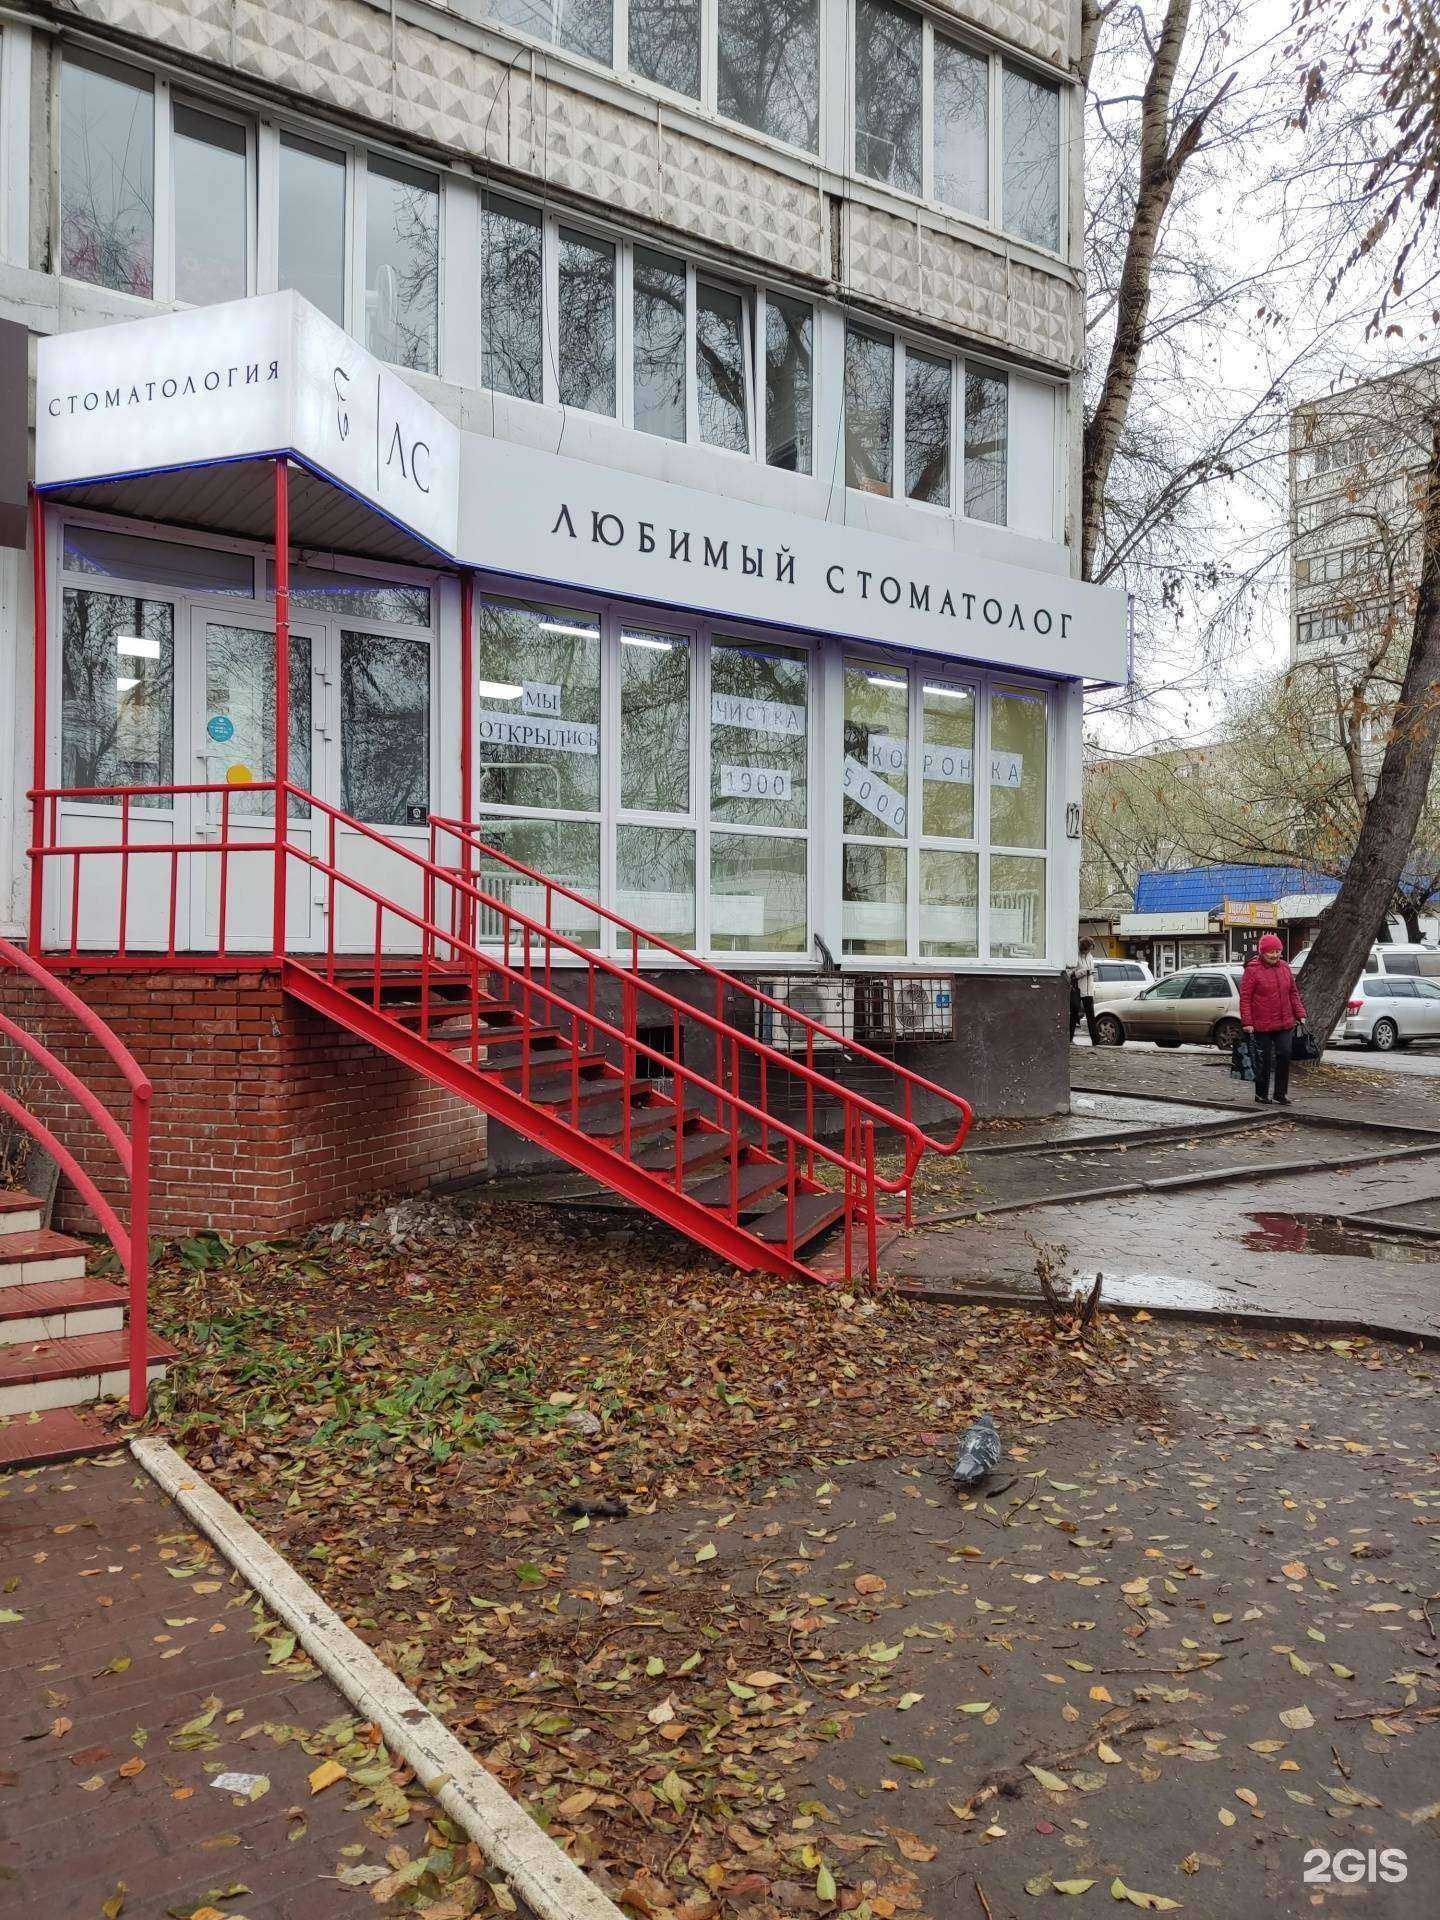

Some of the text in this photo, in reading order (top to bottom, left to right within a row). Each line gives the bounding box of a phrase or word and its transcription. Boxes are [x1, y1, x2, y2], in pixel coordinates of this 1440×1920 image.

[49, 360, 279, 417] СТОМАТОЛОГИЯ
[551, 503, 1073, 639] ЛЮБИМЫЙ СТОМАТОЛОГ
[525, 691, 557, 710] МЫ
[716, 700, 799, 730] ЧИСТКА
[480, 720, 598, 748] ОТКРЫЛИСЬ
[727, 771, 784, 796] 1900
[843, 767, 905, 825] 5000
